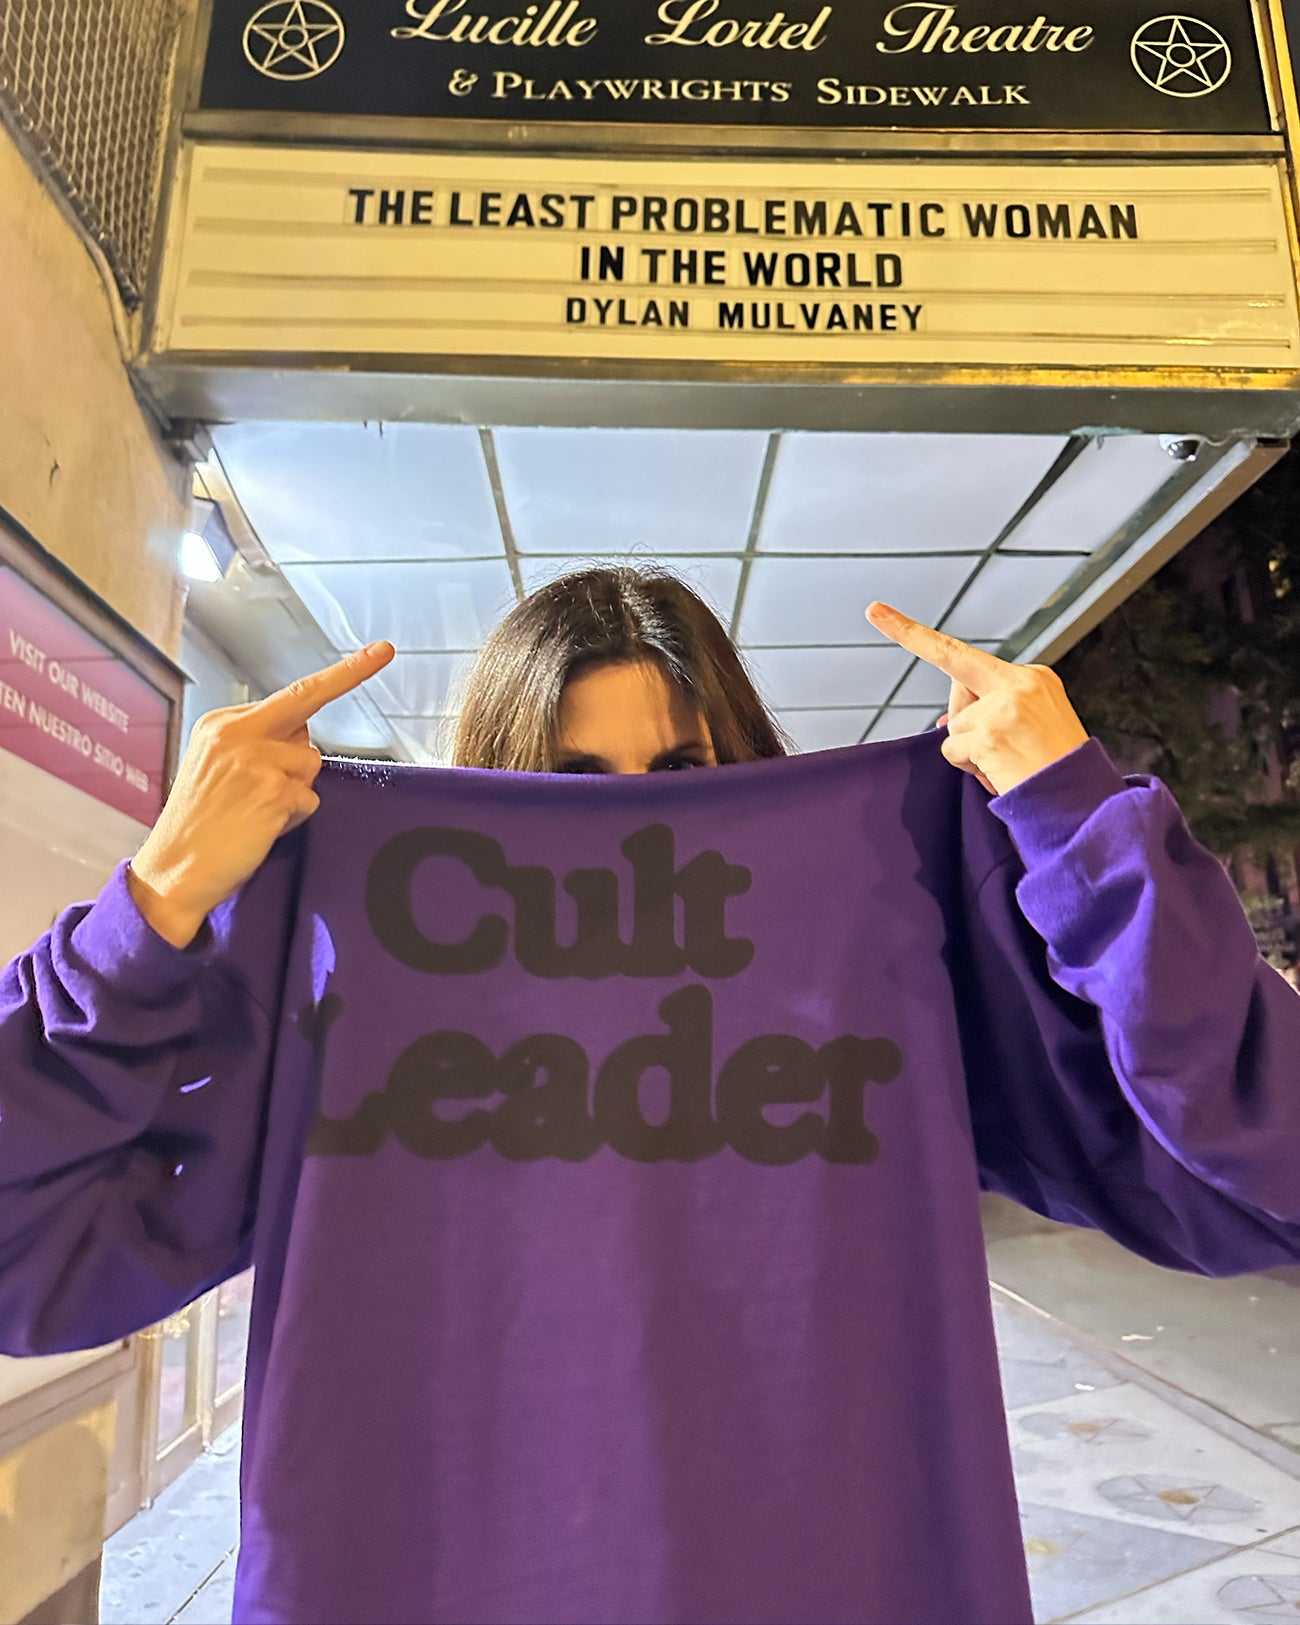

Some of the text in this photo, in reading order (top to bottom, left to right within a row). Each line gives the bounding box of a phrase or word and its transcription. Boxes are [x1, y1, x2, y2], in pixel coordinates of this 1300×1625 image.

[391, 0, 1095, 54] Lucille Lortel Theatre
[448, 69, 479, 97] &
[349, 189, 1138, 240] THE LEAST PROBLEMATIC WOMAN
[580, 245, 902, 288] IN THE WORLD
[566, 297, 924, 332] DYLAN MULVANEY
[9, 629, 129, 733] VISIT OUR WEBSITE
[29, 700, 92, 757] NUESTRO
[365, 823, 756, 980] Cult
[298, 984, 902, 1166] Leader
